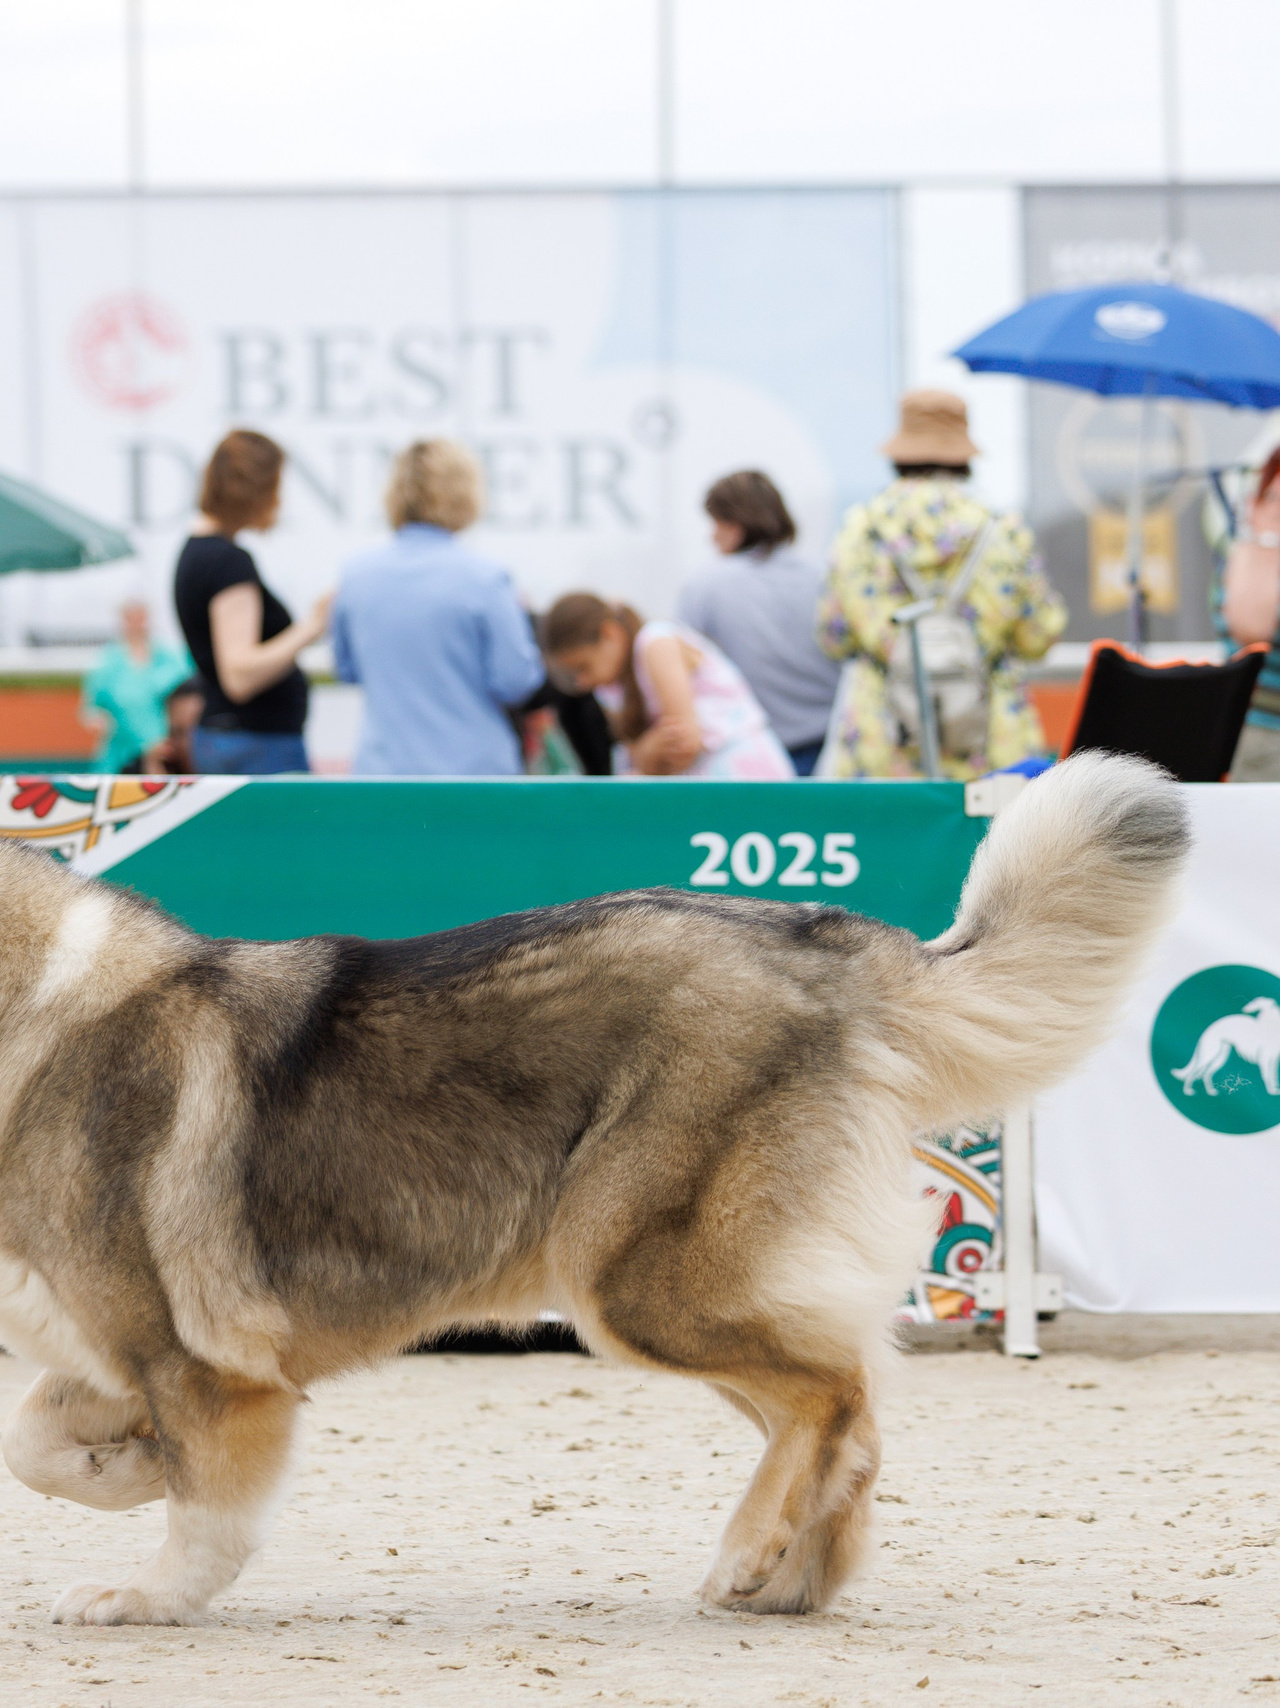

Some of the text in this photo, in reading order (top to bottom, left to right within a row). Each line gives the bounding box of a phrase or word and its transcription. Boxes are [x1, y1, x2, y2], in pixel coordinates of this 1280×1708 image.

[217, 326, 551, 418] BEST
[126, 434, 642, 532] DNER
[689, 831, 861, 887] 2025
